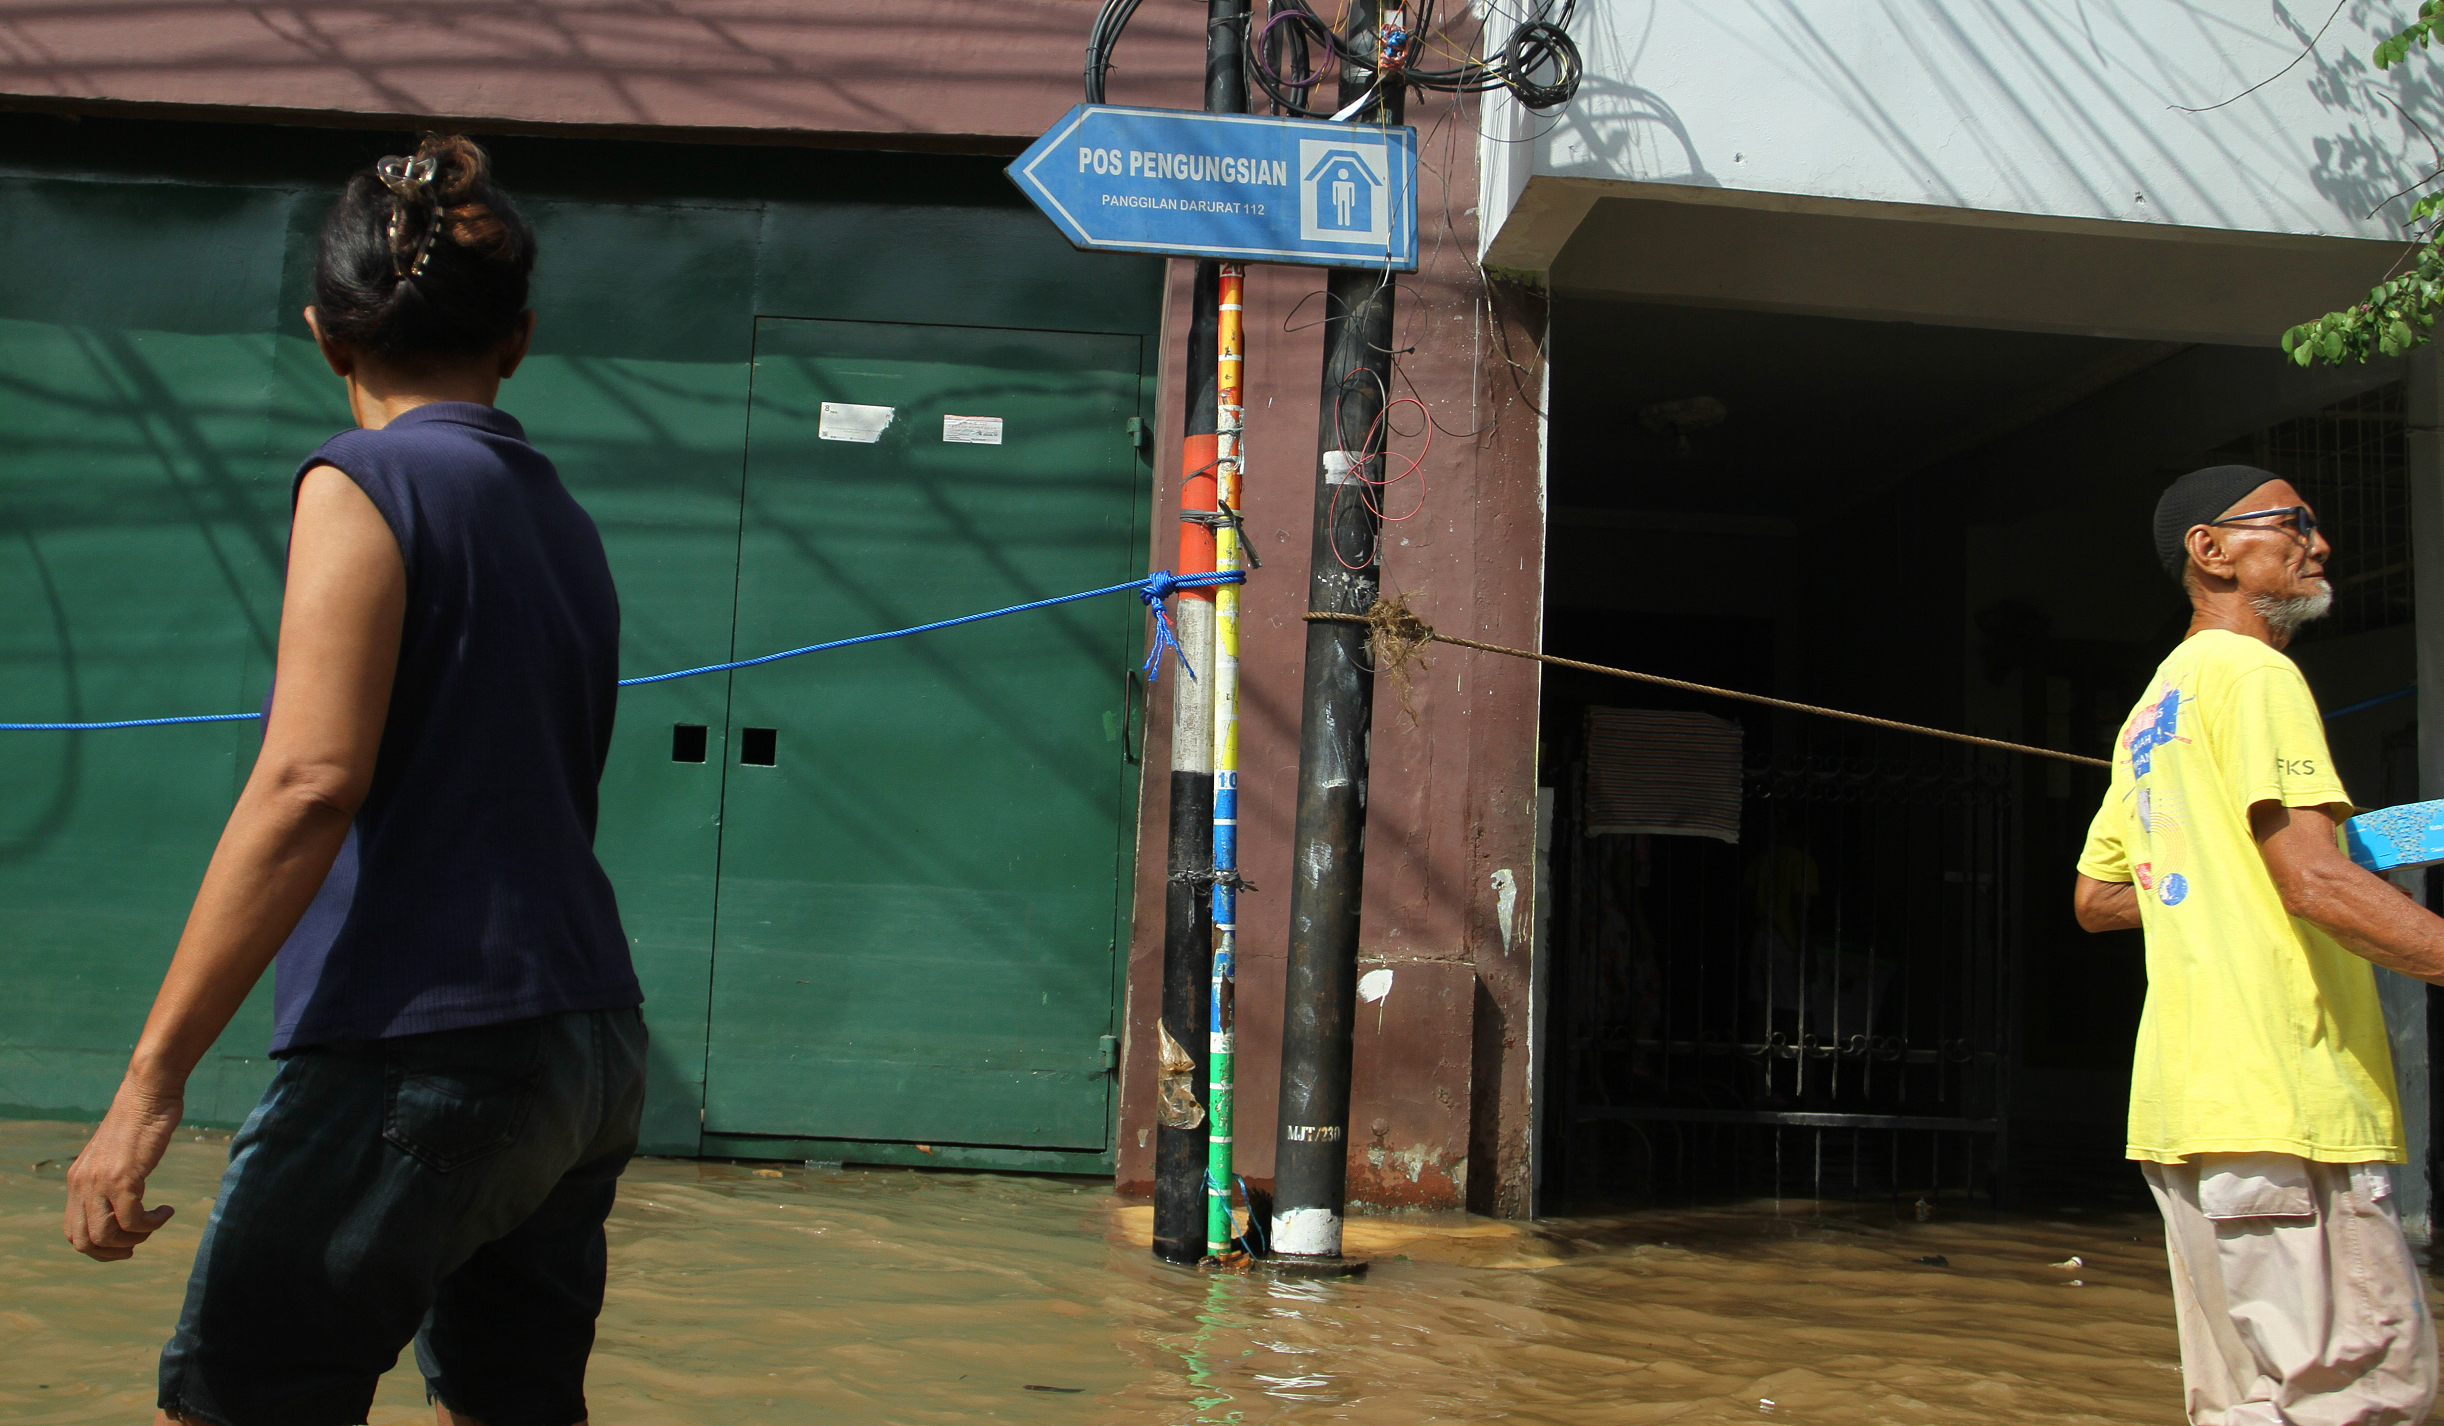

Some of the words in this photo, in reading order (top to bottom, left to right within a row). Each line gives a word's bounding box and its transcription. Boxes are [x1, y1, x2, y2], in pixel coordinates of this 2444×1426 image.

[1079, 146, 1122, 176] POS
[1129, 150, 1287, 187] PENGUNGSIAN
[1102, 194, 1177, 211] PANGGILAN
[1180, 199, 1241, 215] DARURAT
[1243, 203, 1265, 216] 112
[2277, 758, 2315, 776] FKS
[1217, 771, 1237, 788] 10
[1287, 1124, 1341, 1142] MJT/230
